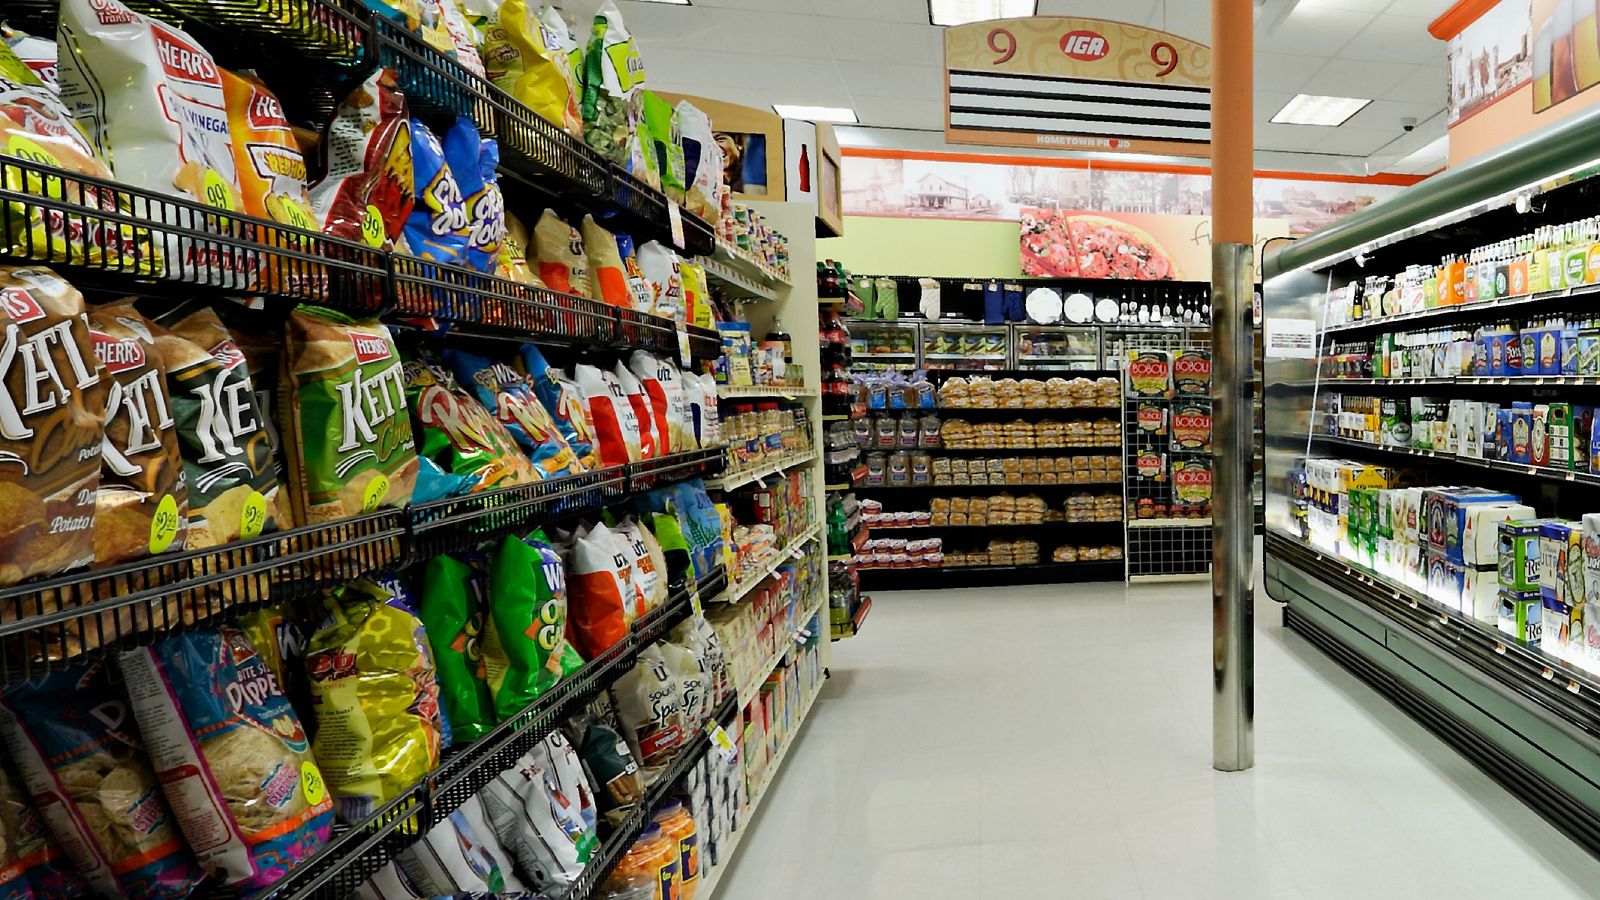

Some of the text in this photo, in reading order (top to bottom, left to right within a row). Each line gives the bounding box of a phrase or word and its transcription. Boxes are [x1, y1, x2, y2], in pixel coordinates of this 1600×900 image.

[987, 28, 1017, 65] 9
[1064, 35, 1105, 56] IGA
[1151, 41, 1178, 77] 9
[256, 97, 287, 121] HE
[188, 109, 228, 134] VINEGA
[1037, 135, 1130, 148] HOMETOWN PRUD
[49, 515, 89, 534] Potato
[226, 674, 284, 714] DIPPE
